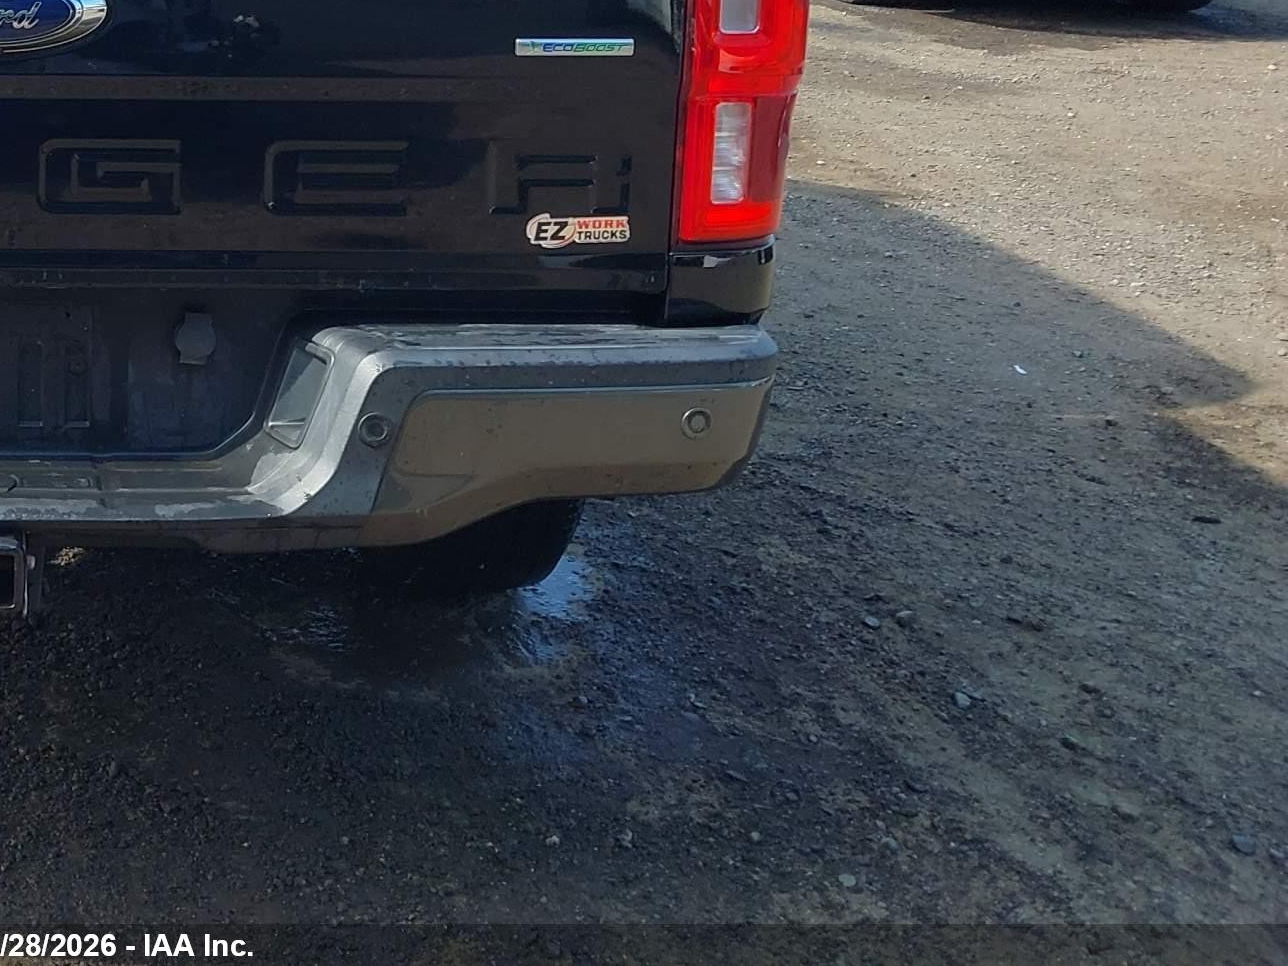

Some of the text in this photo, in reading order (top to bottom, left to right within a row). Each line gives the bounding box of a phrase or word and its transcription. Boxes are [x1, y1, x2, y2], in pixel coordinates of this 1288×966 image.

[576, 219, 627, 229] WORK
[534, 220, 570, 241] EZ
[576, 229, 628, 240] TRUCKS
